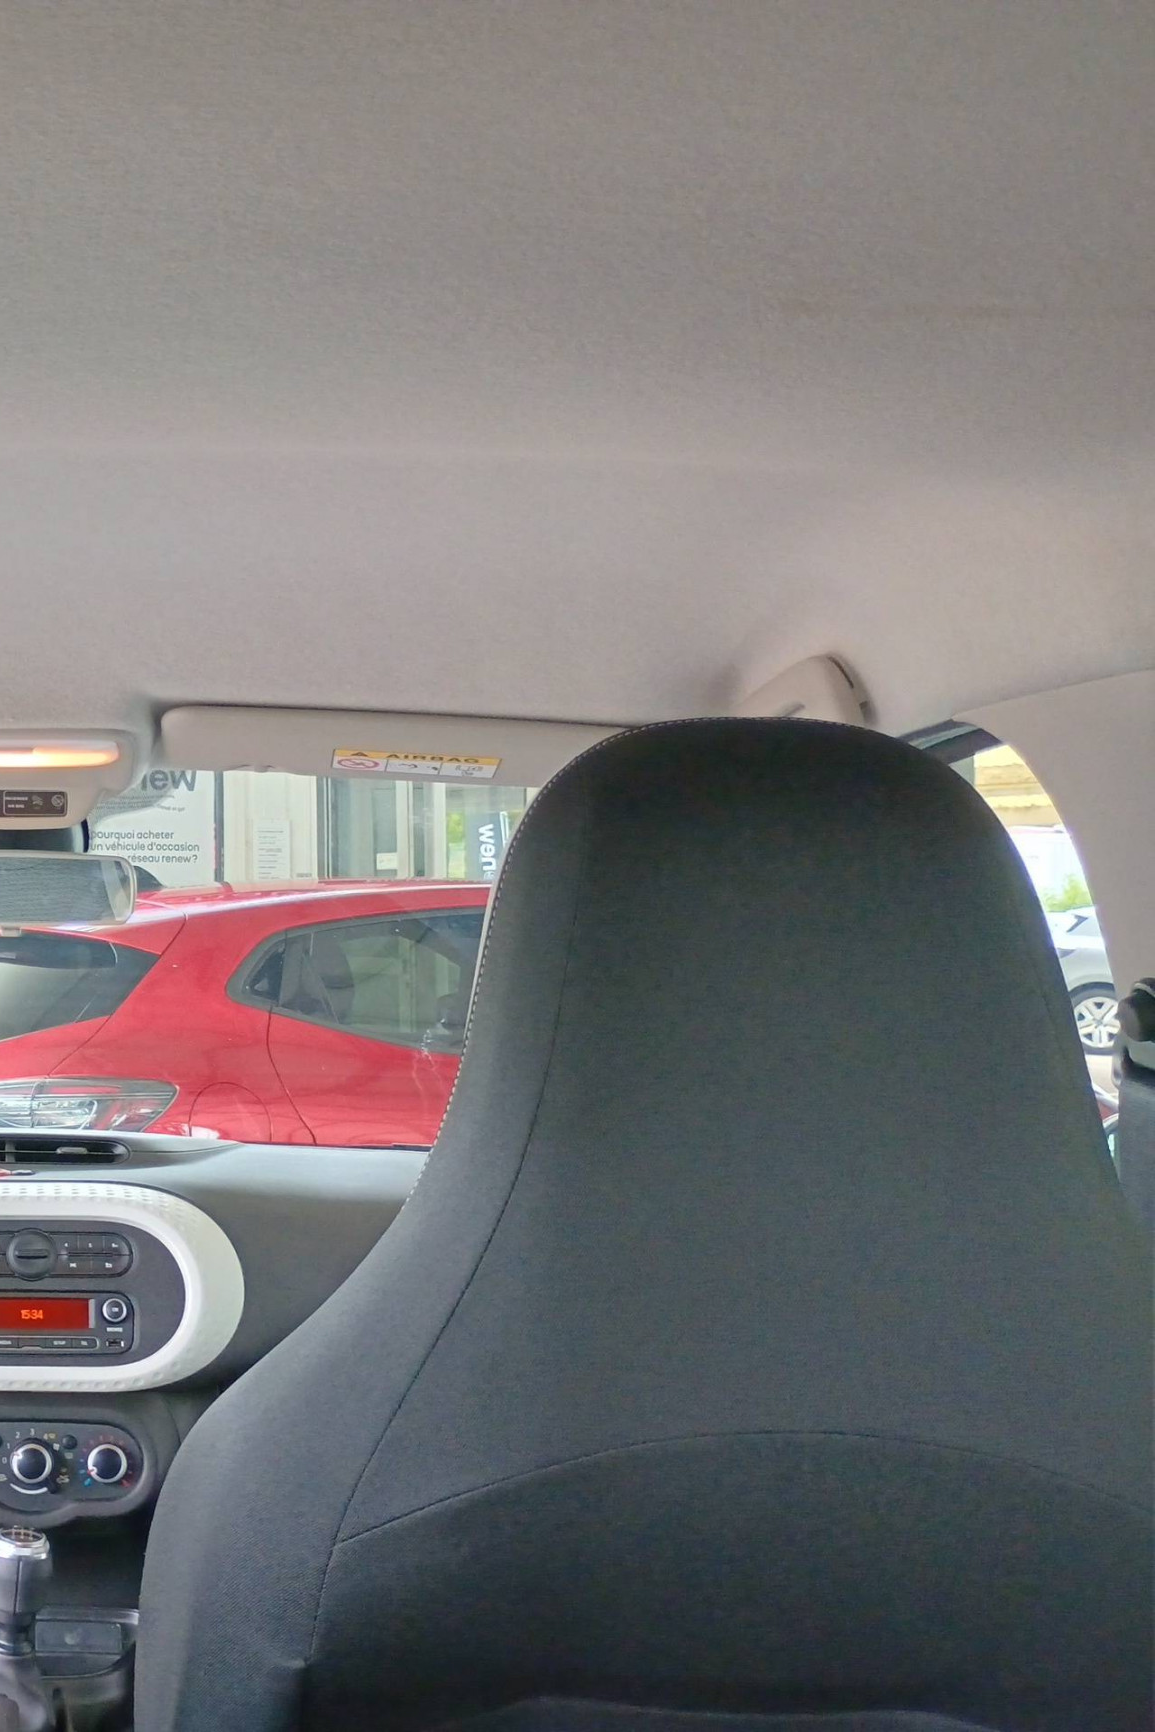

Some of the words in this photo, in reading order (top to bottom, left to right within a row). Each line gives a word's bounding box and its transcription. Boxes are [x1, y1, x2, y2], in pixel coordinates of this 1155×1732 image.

[386, 753, 479, 764] AIRBAG
[136, 830, 174, 840] acheter
[105, 841, 146, 852] véhicule
[147, 841, 200, 853] d'occasion
